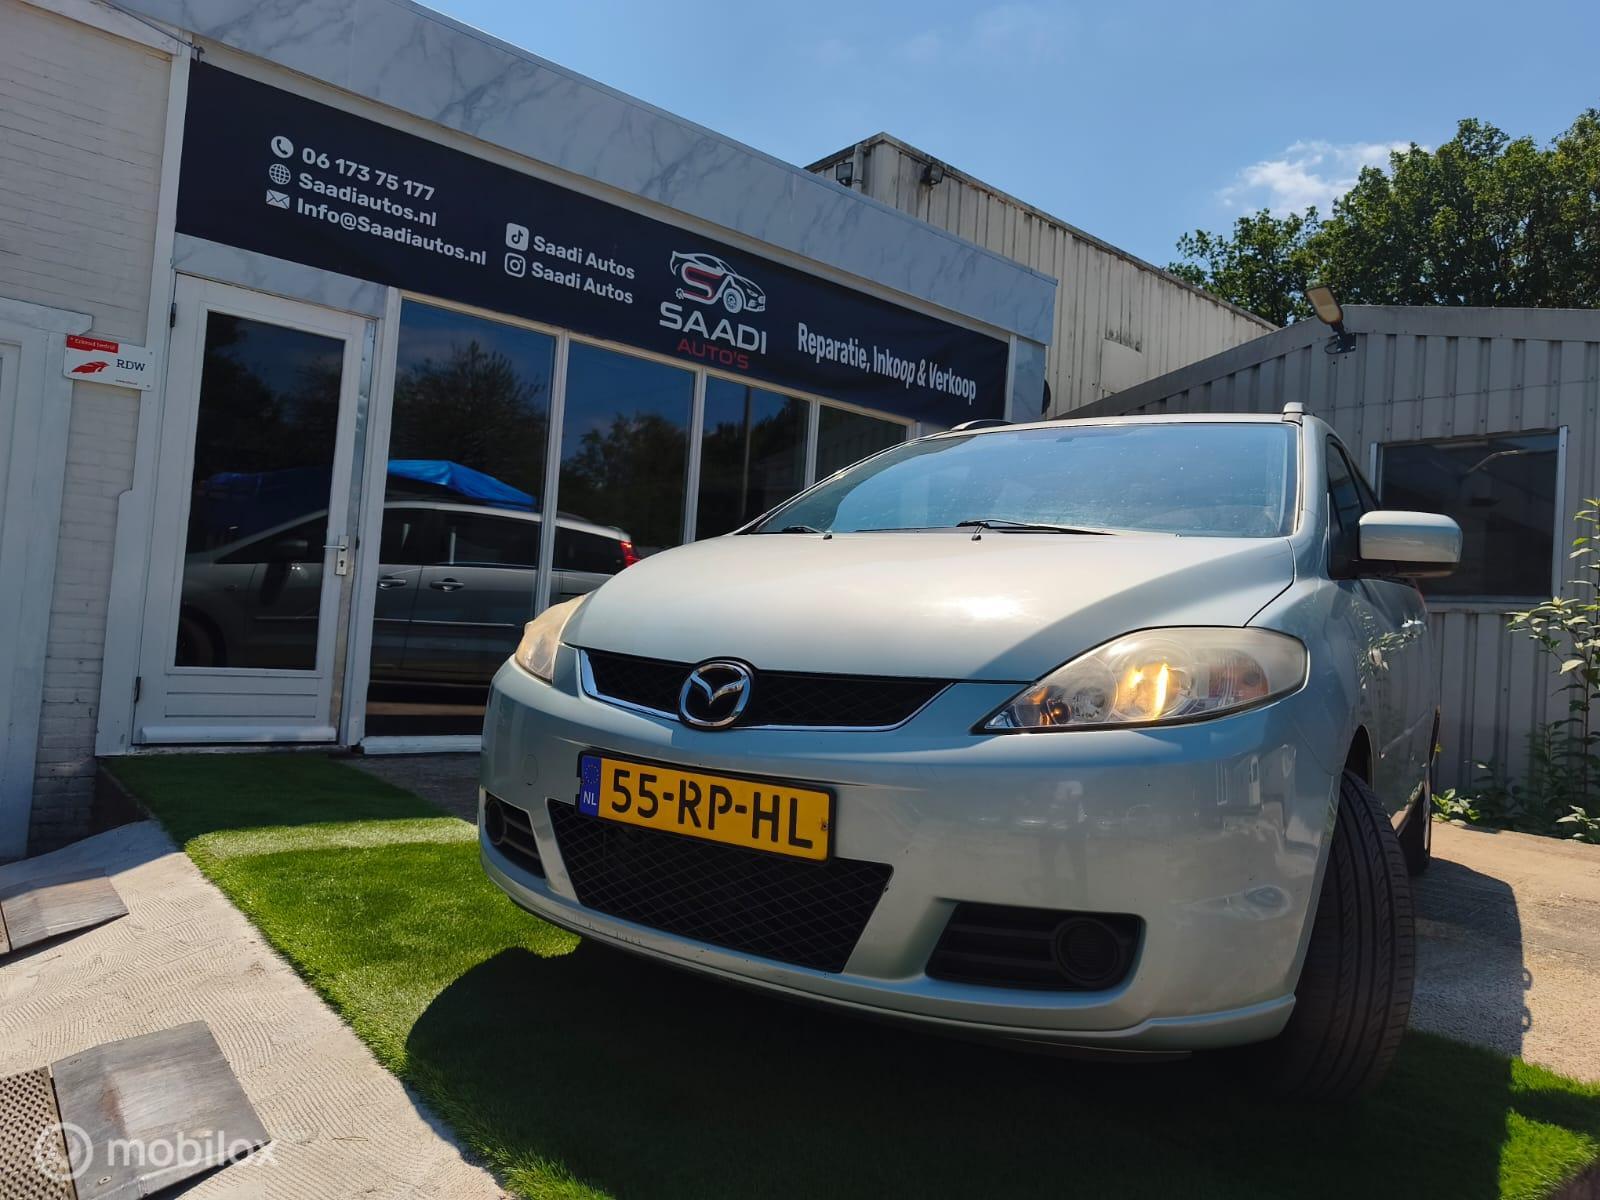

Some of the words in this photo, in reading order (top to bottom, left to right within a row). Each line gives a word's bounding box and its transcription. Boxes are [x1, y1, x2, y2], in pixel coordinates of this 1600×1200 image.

[299, 172, 437, 227] Saadiautos.nl
[302, 148, 330, 168] 06
[335, 159, 370, 182] 173
[375, 170, 399, 190] 75
[403, 180, 435, 201] 177
[297, 198, 487, 265] Info@Saadiautos.nl
[533, 235, 582, 265] Saadi
[585, 252, 635, 280] Autos
[531, 262, 581, 290] Saadi
[583, 278, 633, 304] Autos
[659, 301, 767, 354] SAADI
[677, 337, 749, 369] AUTO'S
[116, 358, 146, 372] RDW
[797, 322, 871, 373] Reparatie,
[873, 345, 916, 389] Inkoop
[917, 358, 926, 388] &
[929, 361, 977, 405] Verkoop
[583, 791, 597, 806] NL
[611, 768, 813, 850] 55-RP-HL
